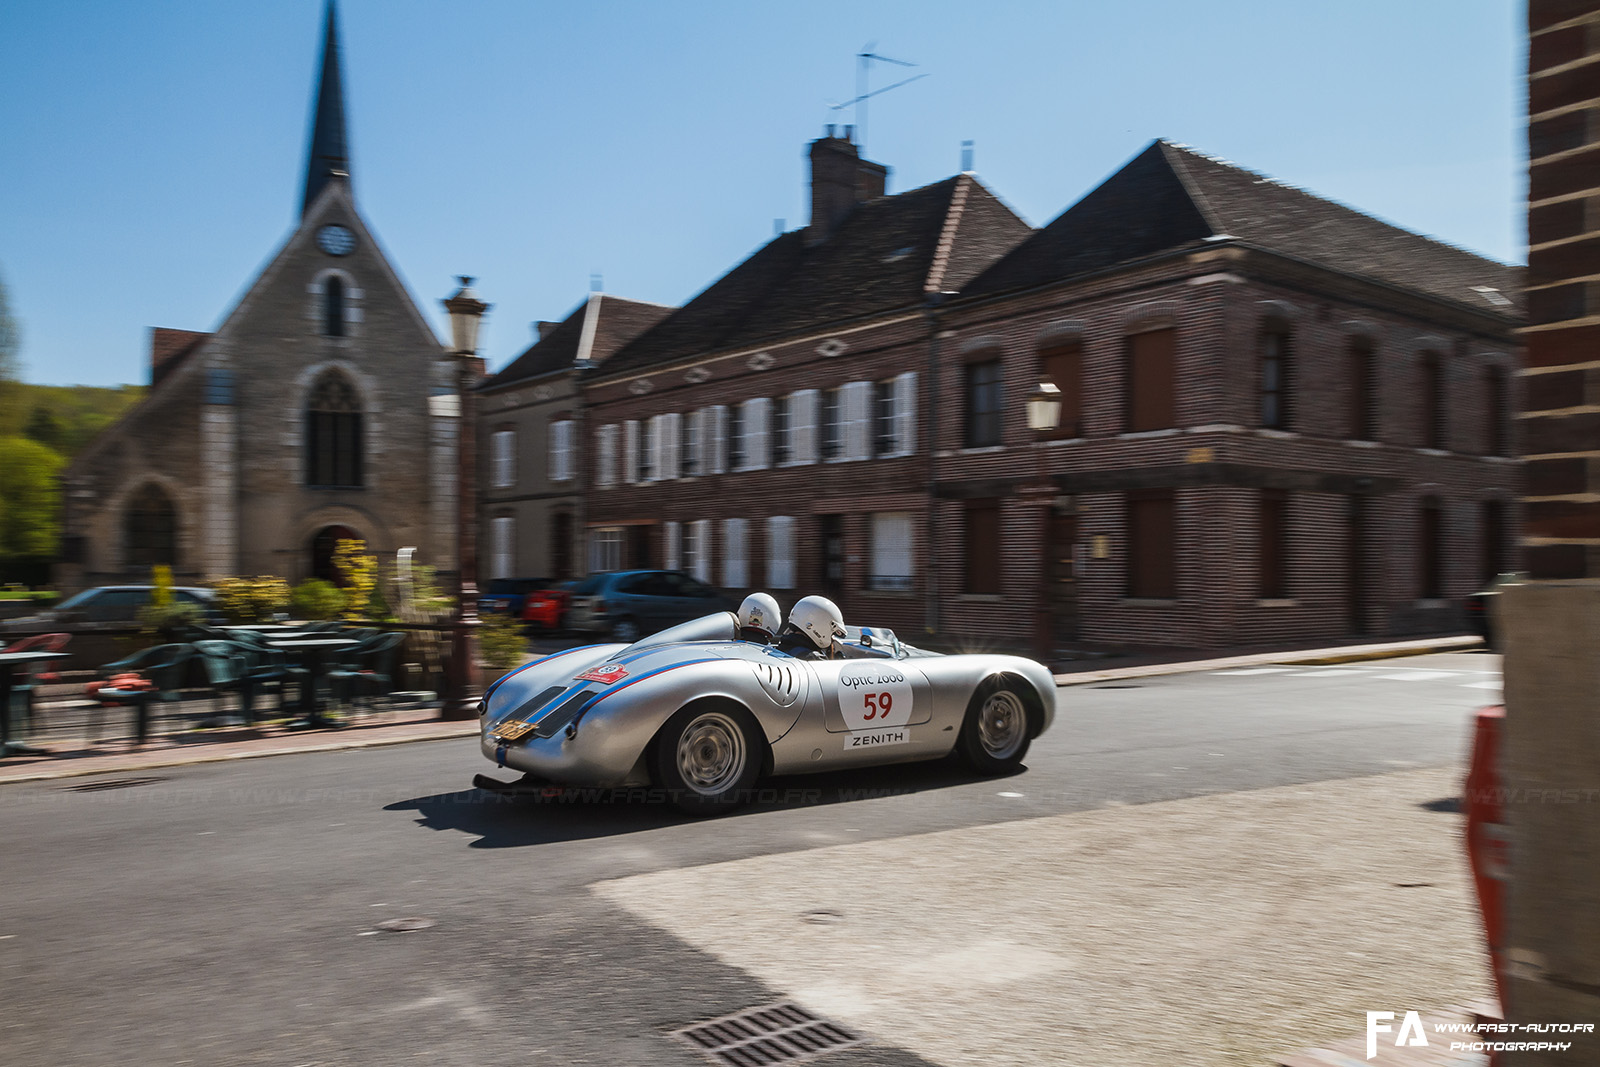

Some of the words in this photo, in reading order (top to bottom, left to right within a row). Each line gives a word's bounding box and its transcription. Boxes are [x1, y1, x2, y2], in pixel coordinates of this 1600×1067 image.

[841, 675, 874, 690] Optic
[877, 674, 904, 684] 2000
[863, 692, 893, 720] 59
[852, 732, 904, 746] ZENITH
